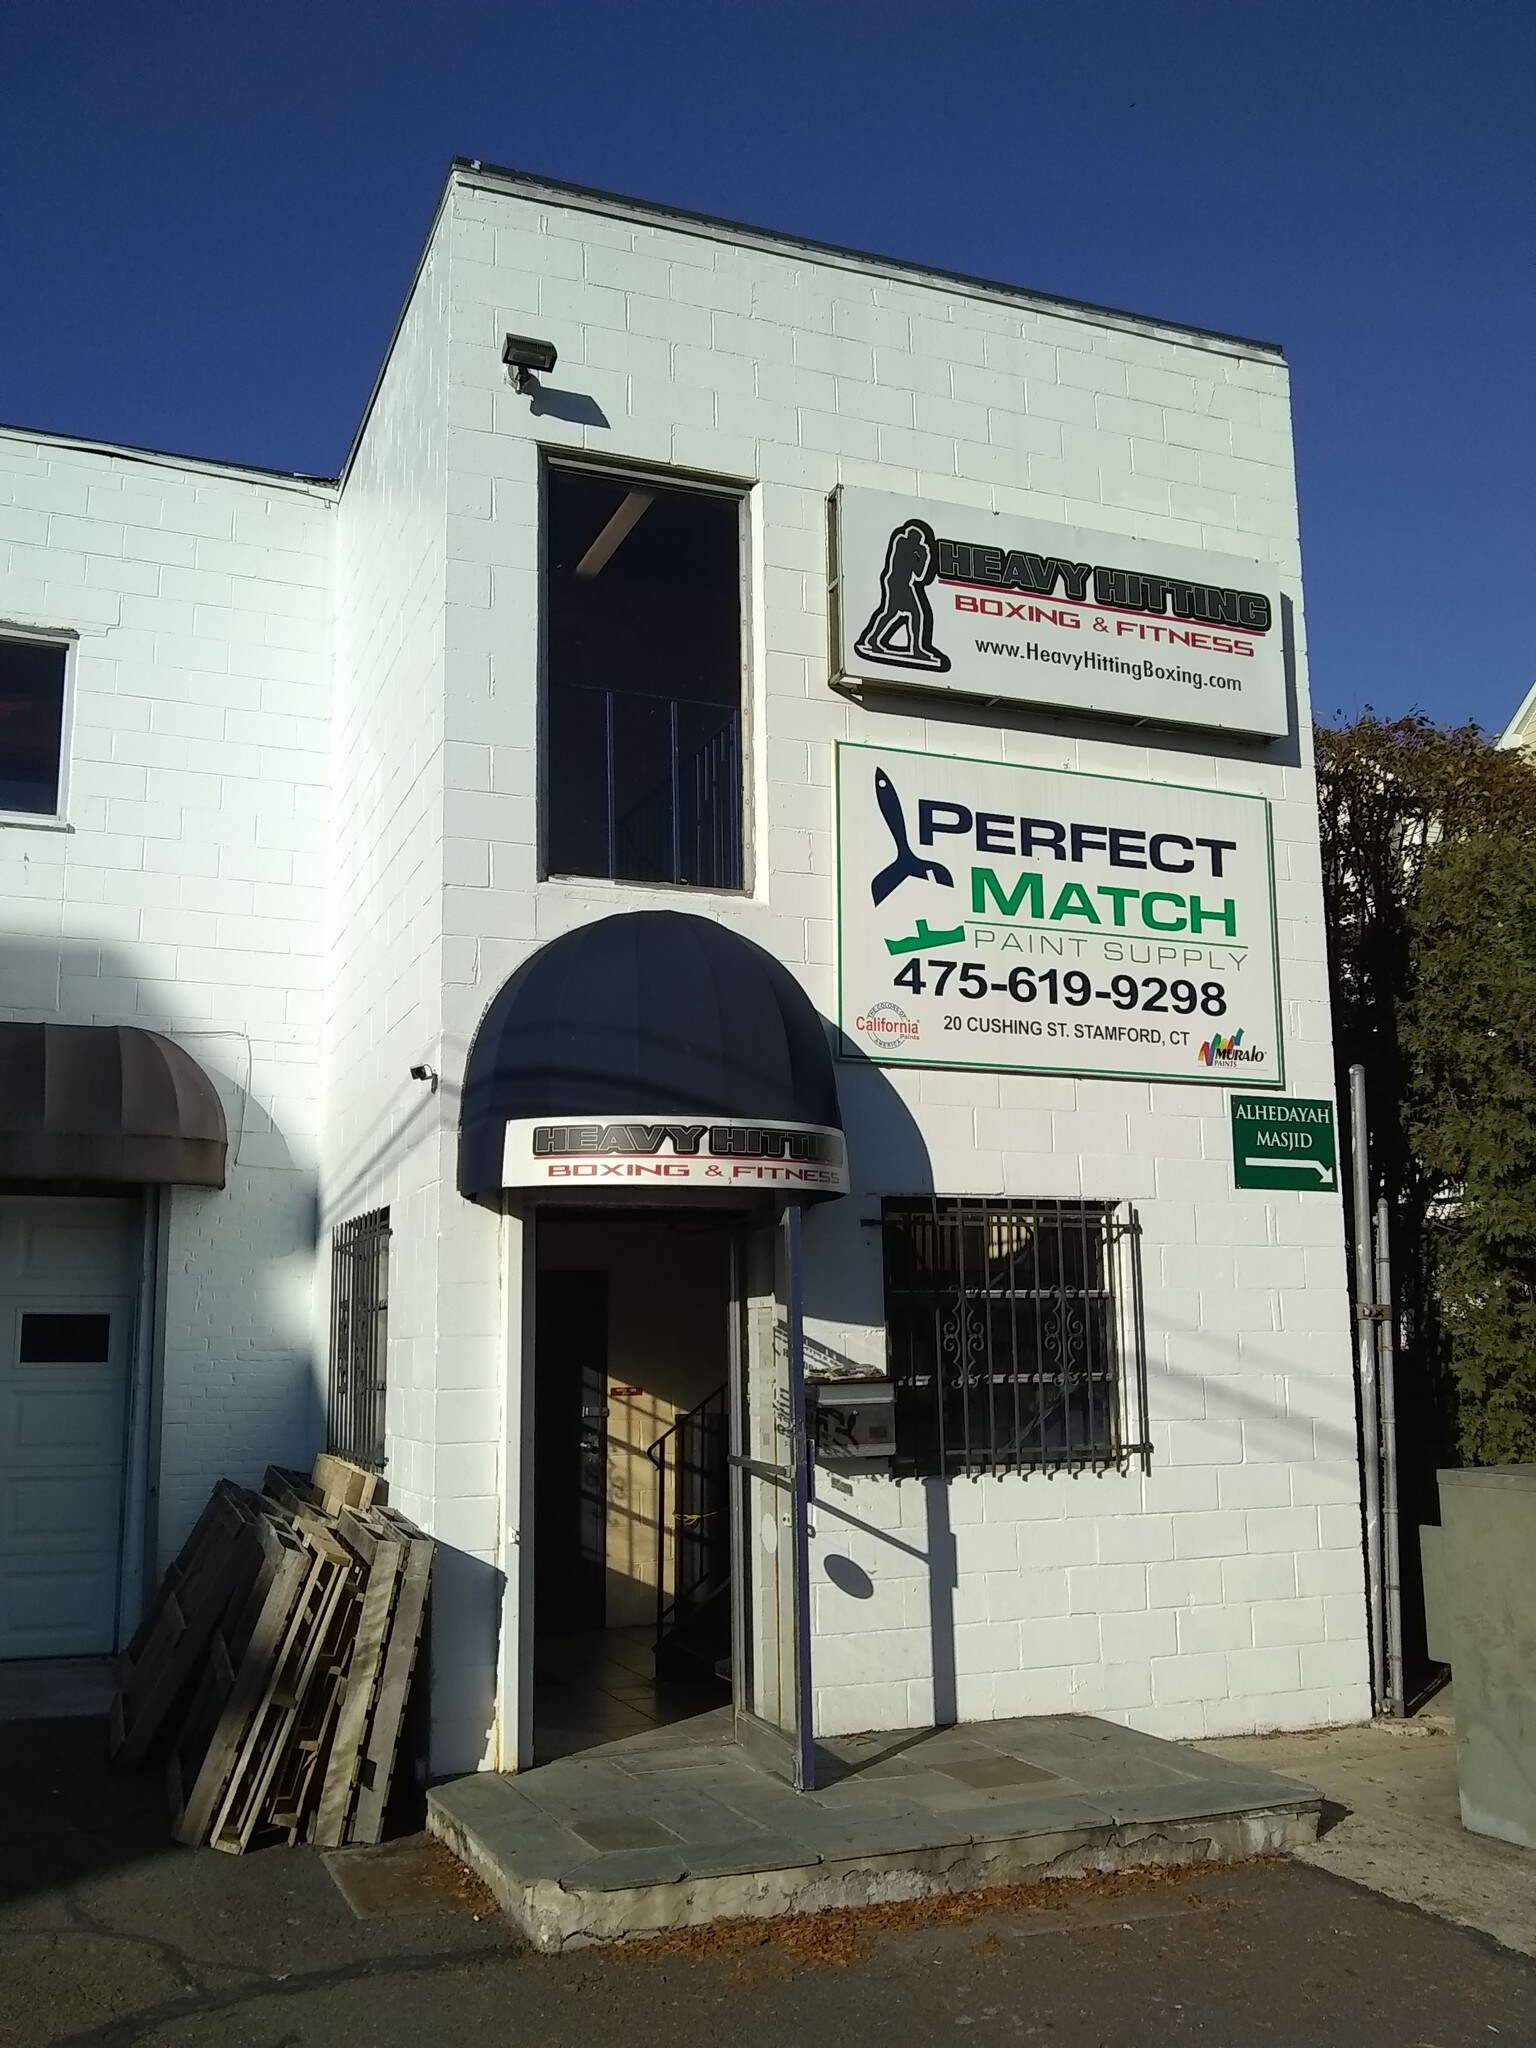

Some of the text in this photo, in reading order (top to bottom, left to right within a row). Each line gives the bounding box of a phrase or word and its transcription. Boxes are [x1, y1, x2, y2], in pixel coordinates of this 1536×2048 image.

[937, 541, 1270, 630] HEAVY HITTING
[954, 594, 1255, 657] BOXING & FITNESS
[975, 639, 1242, 692] www.HeavyHittingBoxing.com
[918, 798, 1237, 878] PERFECT
[970, 866, 1237, 938] MATCH
[974, 929, 1249, 972] PAINT SUPPLY
[893, 957, 1228, 1017] 475-619-9298
[856, 1016, 919, 1034] California
[900, 1033, 920, 1041] Paints
[943, 1015, 1190, 1047] 20 CUSHING ST. STAMFORD, CT
[1214, 1060, 1238, 1068] PAINTS
[1235, 1103, 1331, 1124] ALHEDAYAH
[534, 1124, 843, 1167] HEAVY HITTI
[1256, 1130, 1313, 1152] MASJID
[548, 1163, 840, 1184] BOXING & FITNESS
